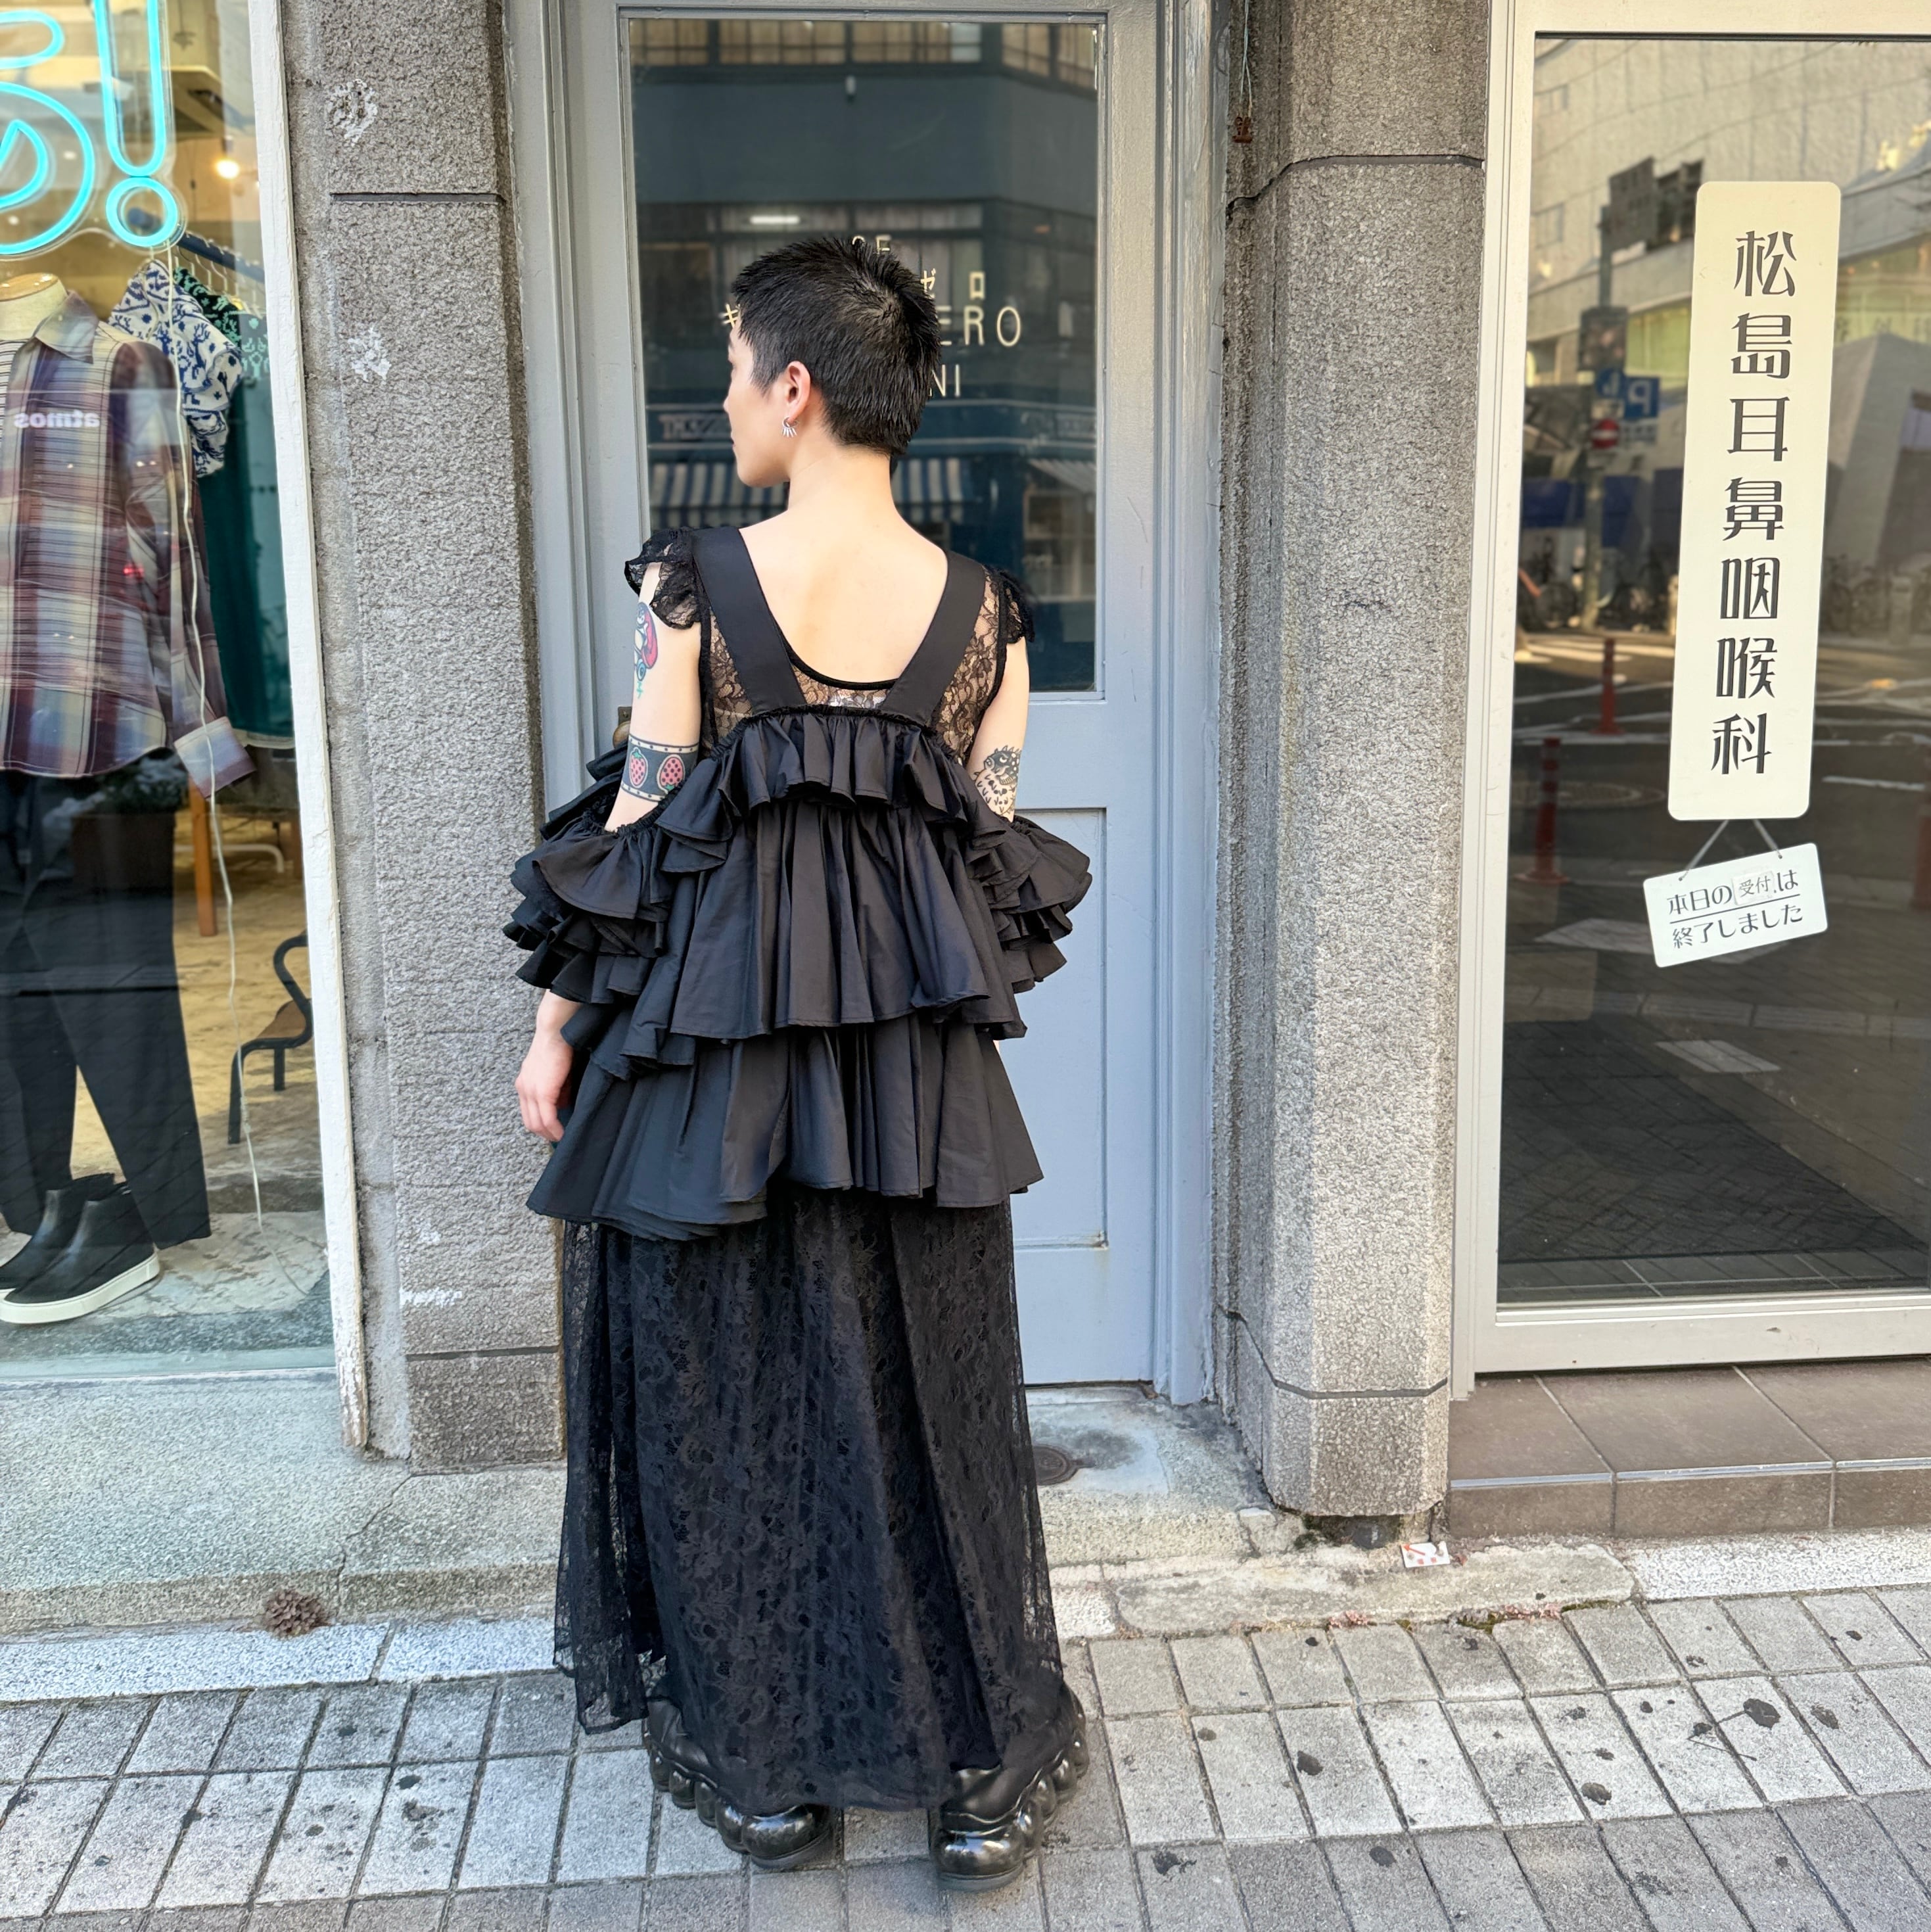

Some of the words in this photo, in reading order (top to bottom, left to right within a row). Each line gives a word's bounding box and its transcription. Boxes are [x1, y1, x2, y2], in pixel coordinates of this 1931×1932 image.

[934, 305, 1021, 347] ERO
[1711, 230, 1797, 776] 松島耳鼻咽喉科
[1672, 904, 1803, 949] 終了しました
